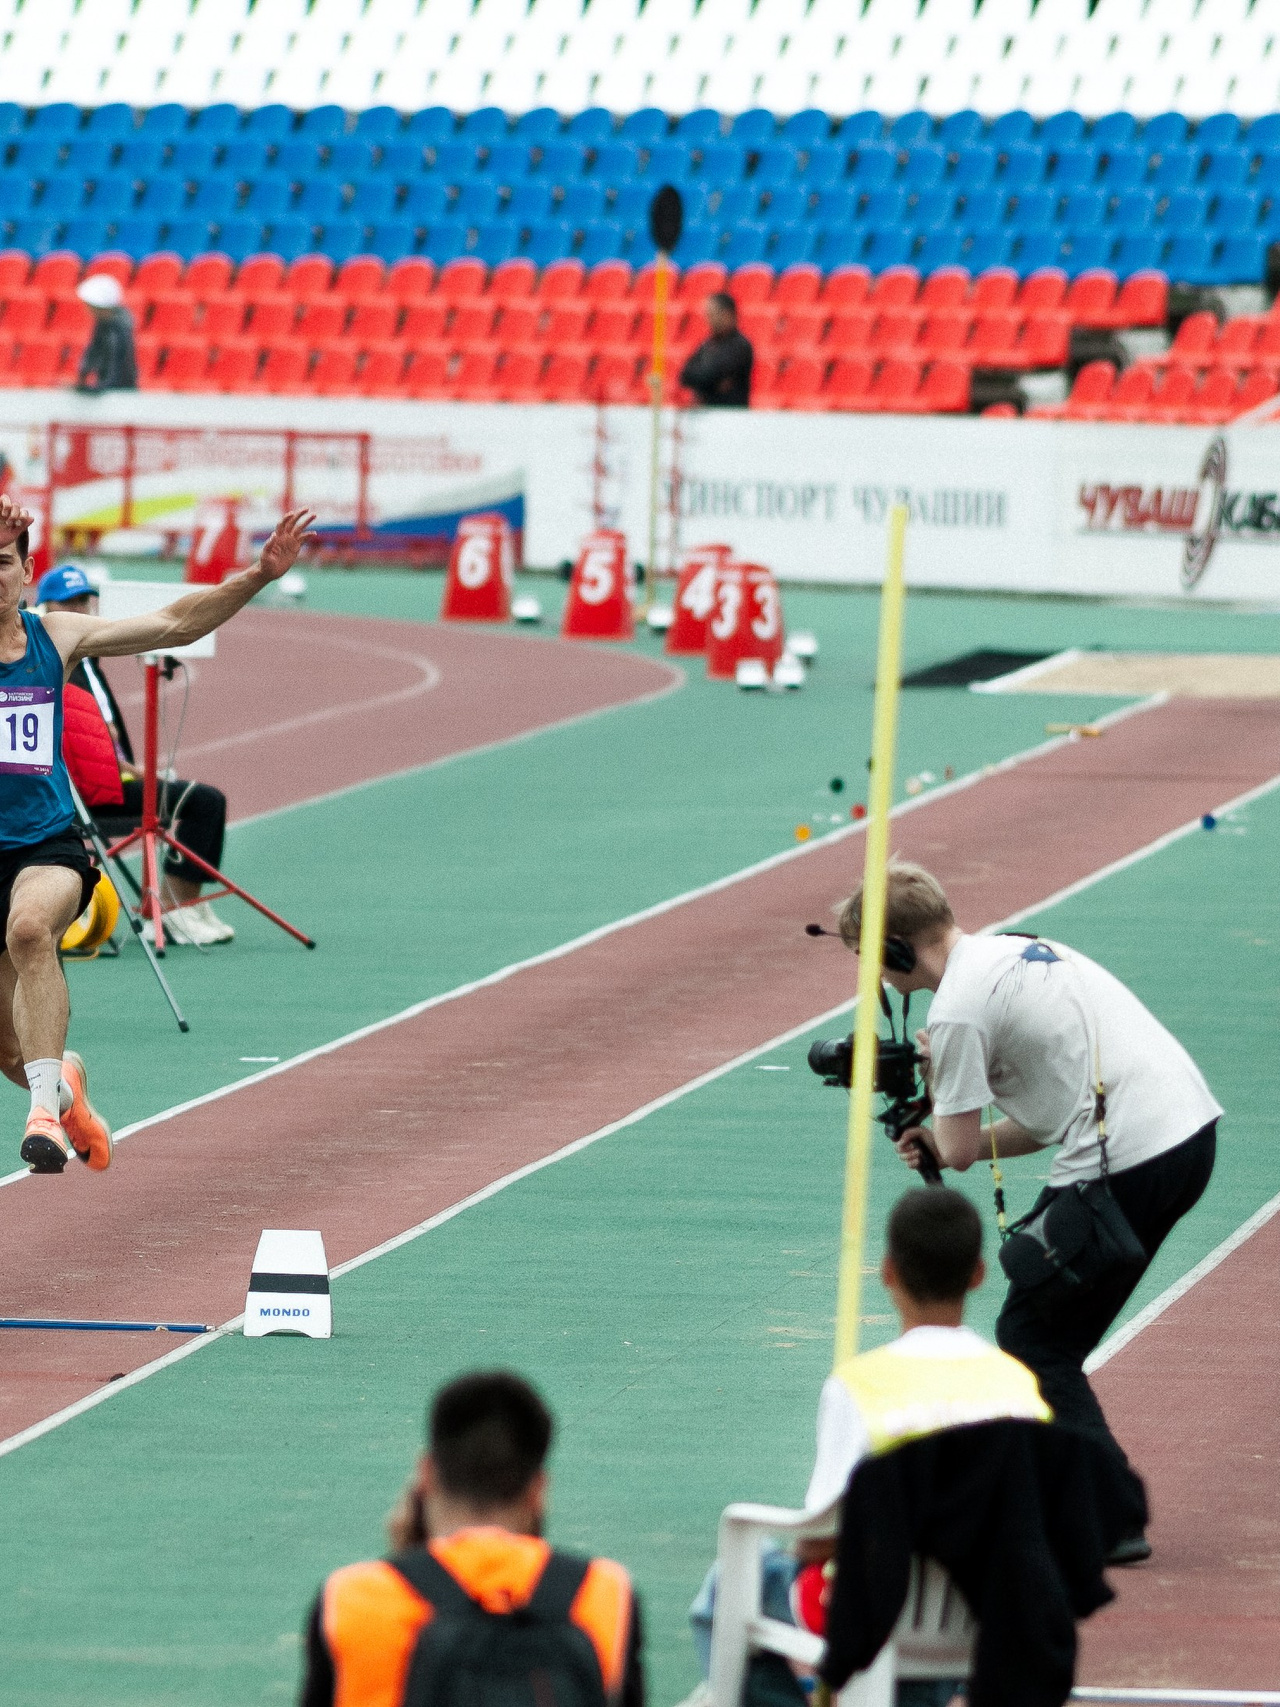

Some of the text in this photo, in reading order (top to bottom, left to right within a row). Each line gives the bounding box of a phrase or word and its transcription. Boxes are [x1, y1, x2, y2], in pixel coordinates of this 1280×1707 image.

[195, 506, 228, 565] 7
[457, 536, 491, 590] 6
[578, 550, 613, 606] 5
[681, 565, 716, 620] 4
[711, 583, 741, 640] 3
[750, 584, 778, 640] 3
[259, 1308, 311, 1317] MONDO
